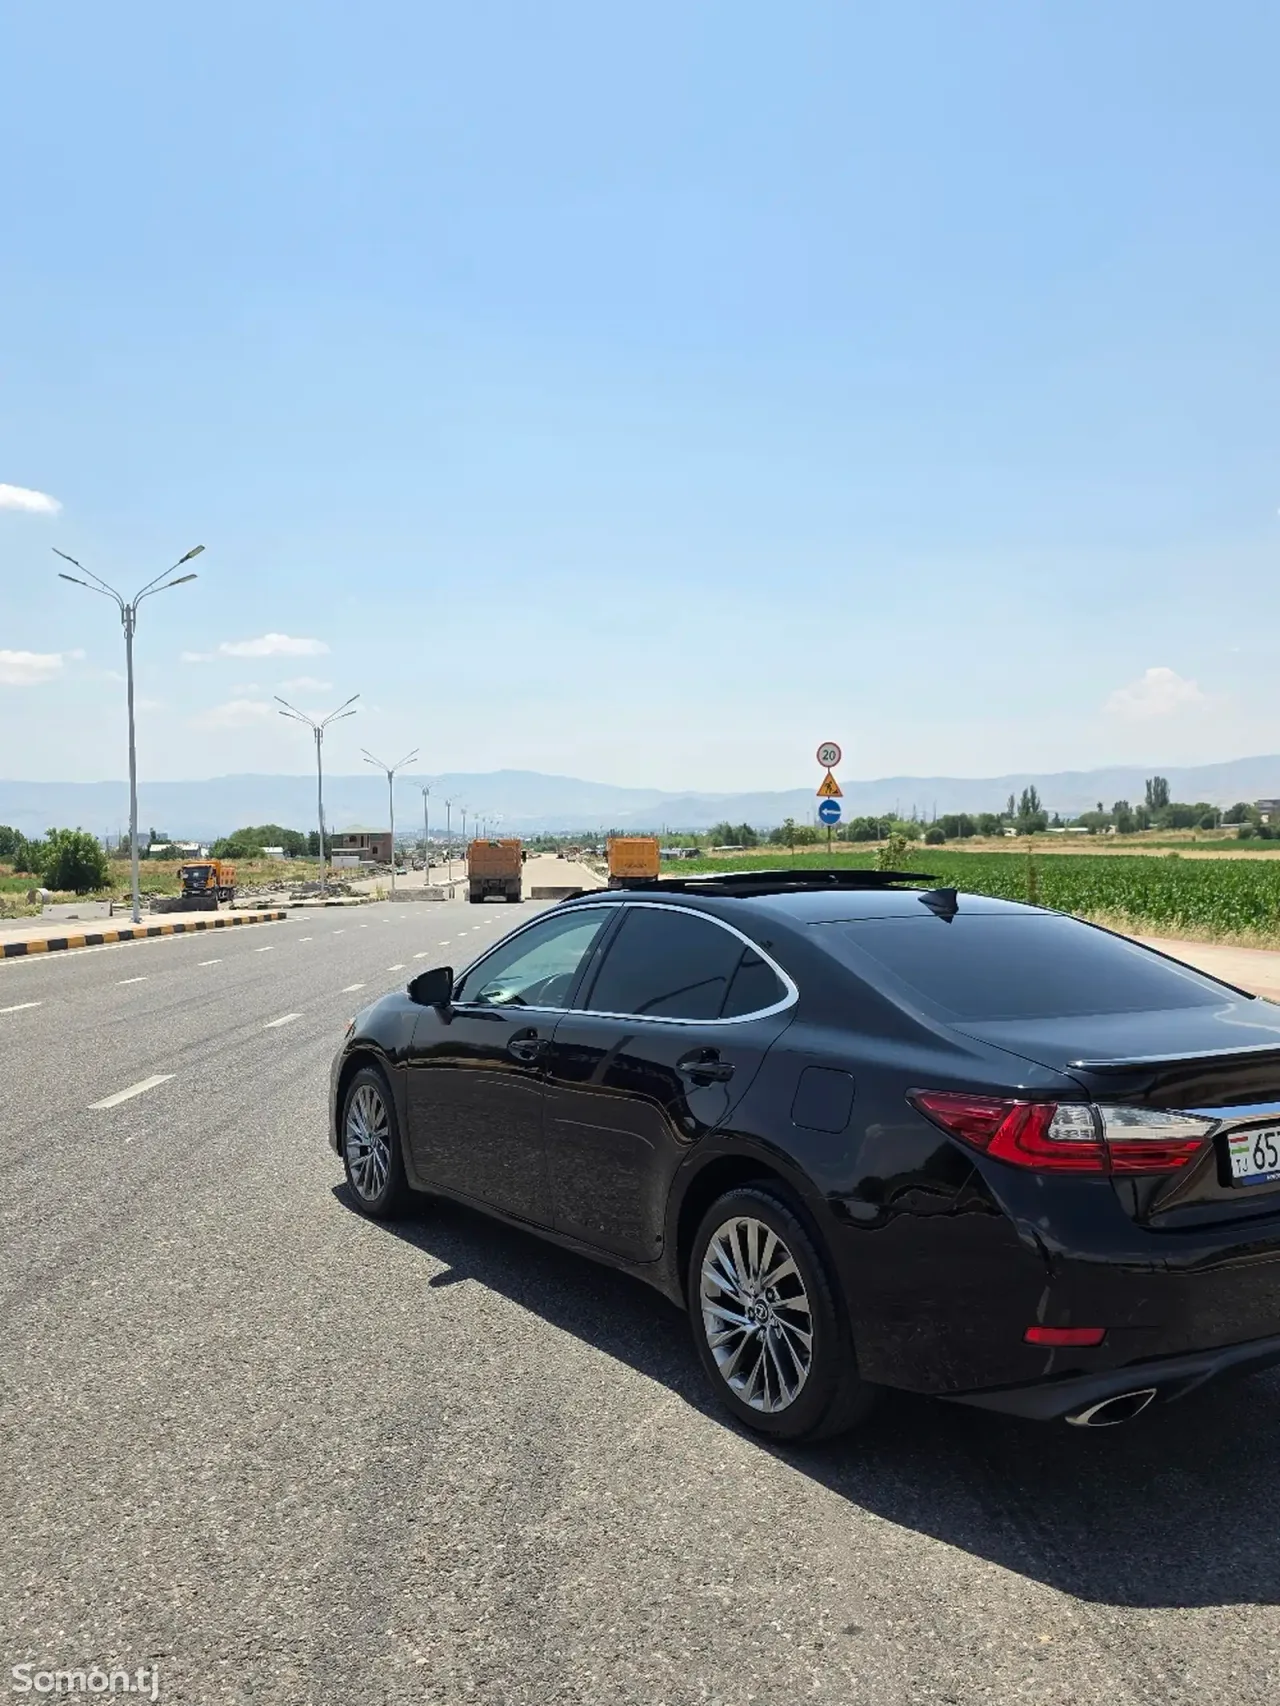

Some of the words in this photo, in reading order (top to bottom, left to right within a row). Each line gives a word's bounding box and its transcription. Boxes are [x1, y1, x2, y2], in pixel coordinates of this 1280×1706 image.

[822, 749, 836, 761] 20
[1236, 1158, 1248, 1173] TJ
[1253, 1131, 1280, 1170] 65
